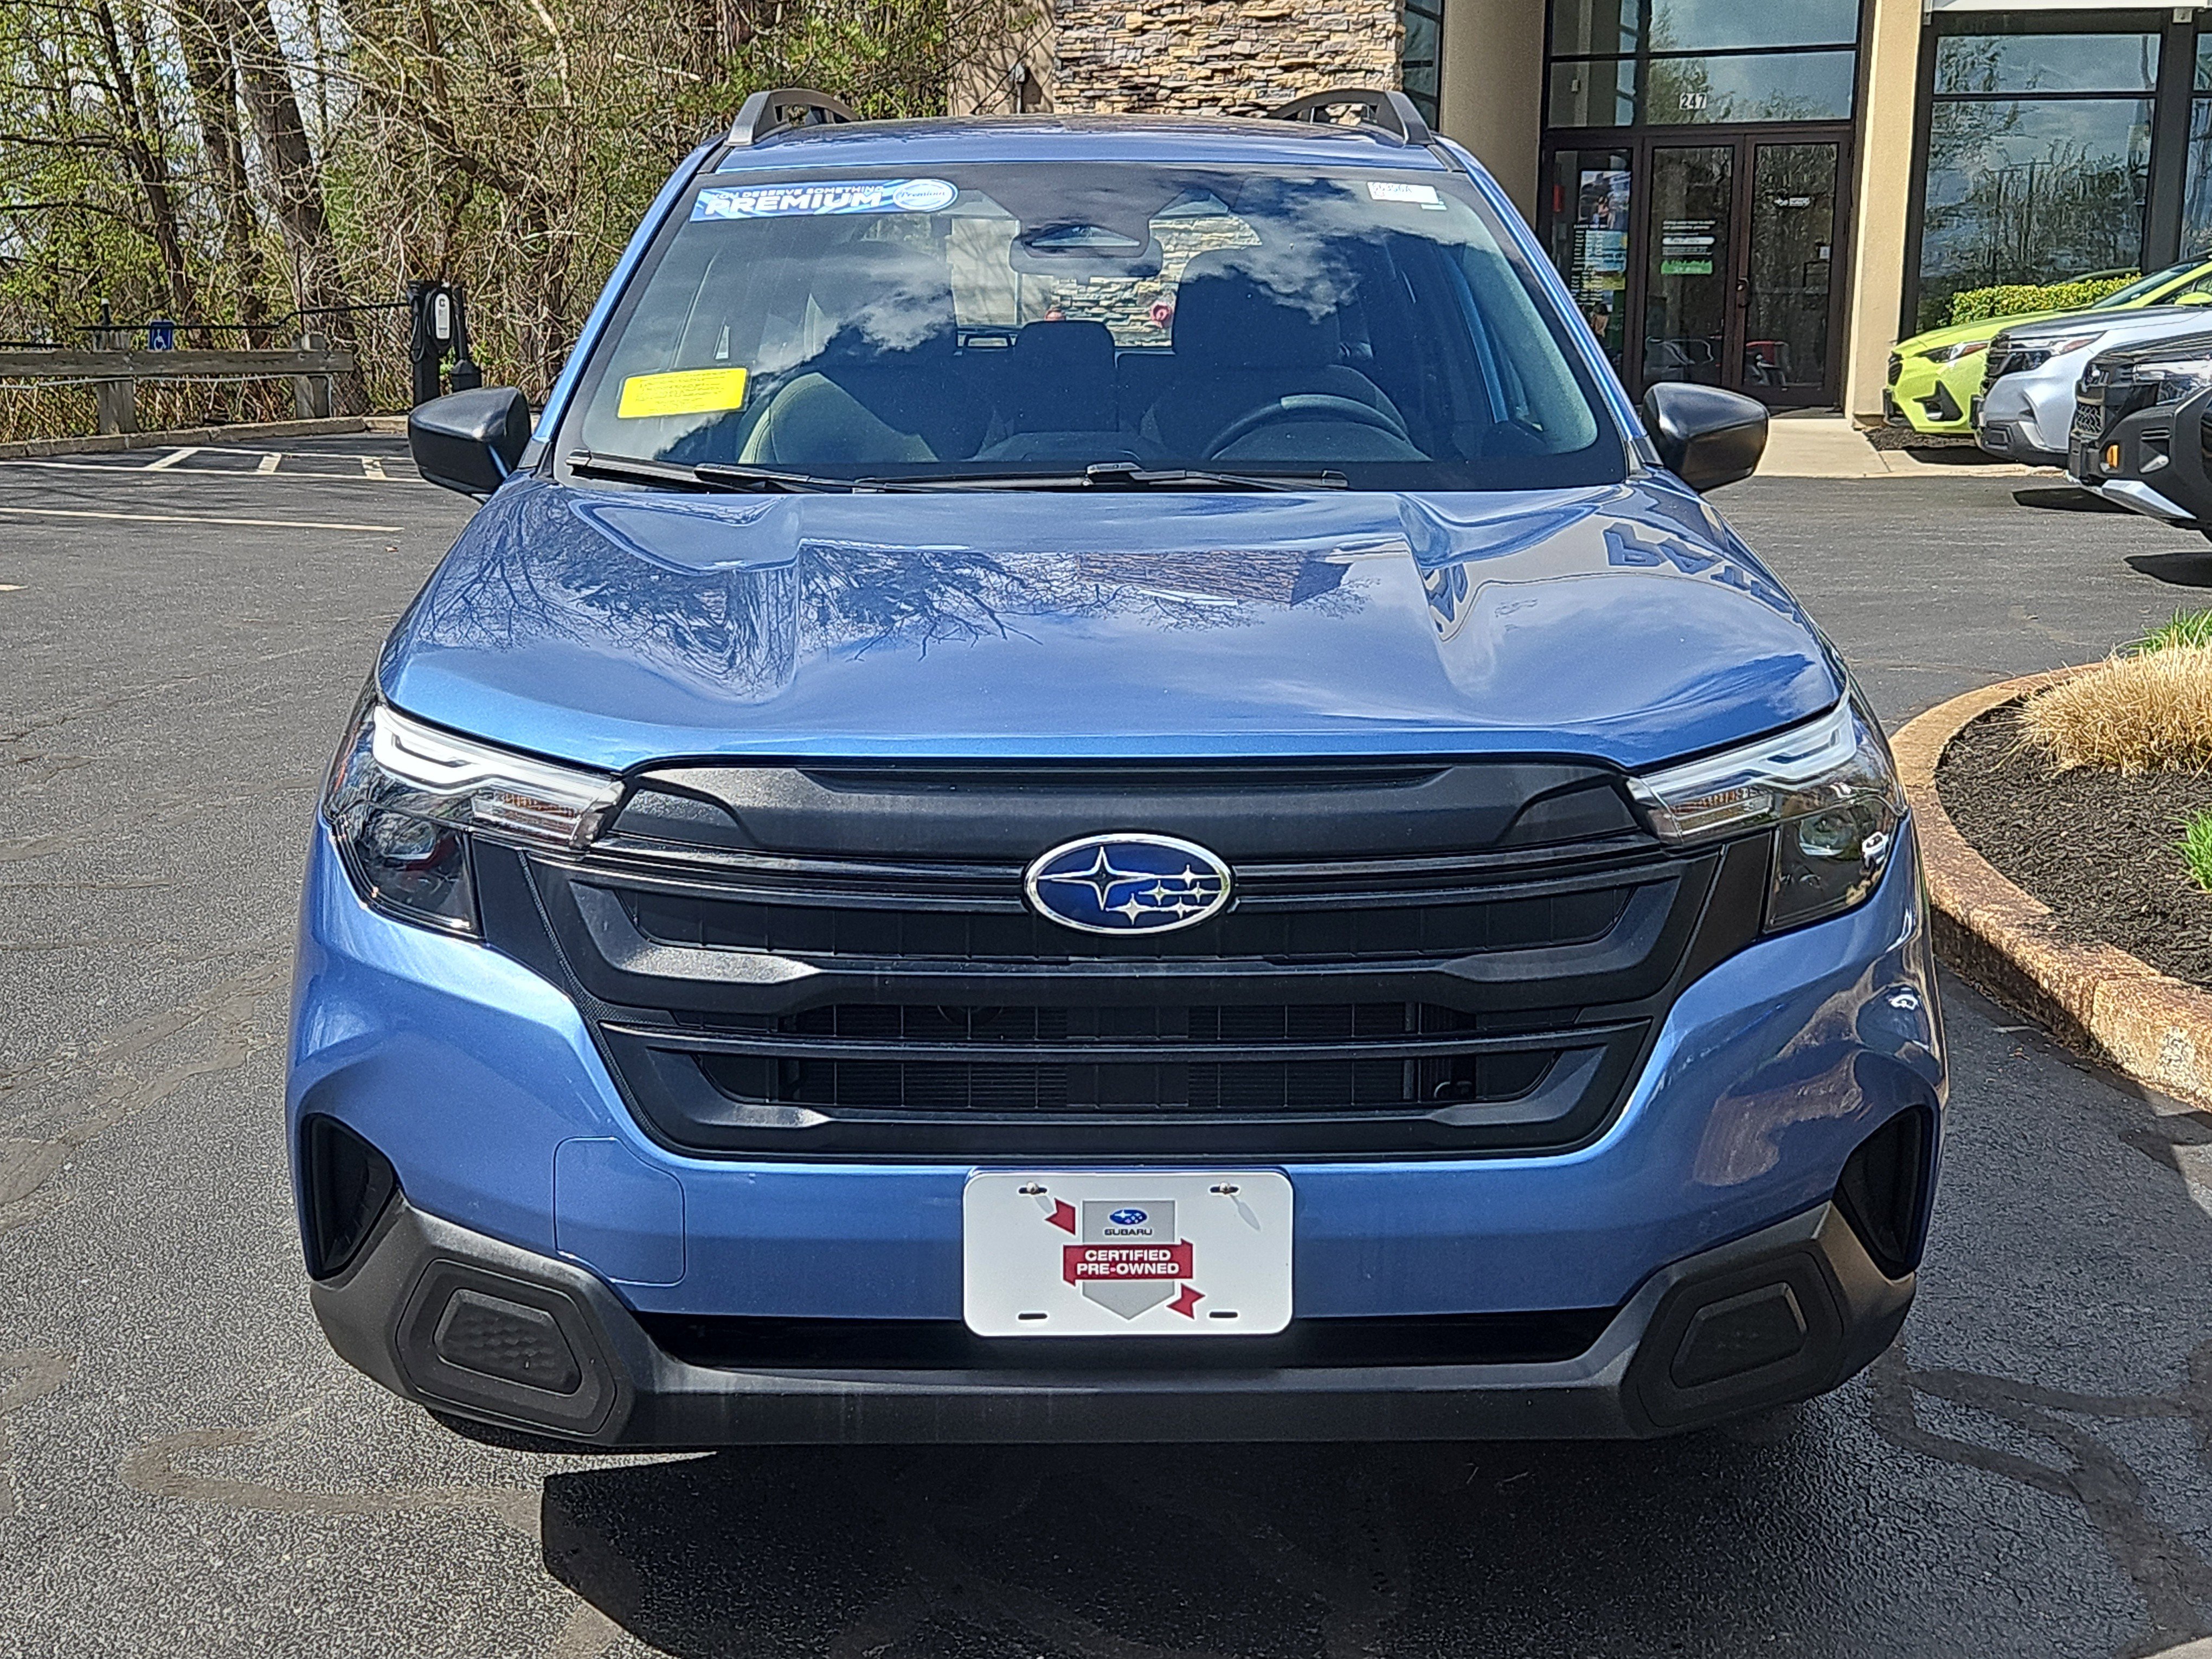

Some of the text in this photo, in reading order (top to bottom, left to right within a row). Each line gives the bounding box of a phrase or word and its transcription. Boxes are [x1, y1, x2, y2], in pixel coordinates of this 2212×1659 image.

[1681, 94, 1705, 109] 247
[712, 186, 884, 200] YOU DESERVE SOMETHING
[705, 191, 883, 215] PREMIUM
[1085, 1250, 1171, 1262] CERTIFIED
[1077, 1263, 1179, 1275] PRE-OWNED
